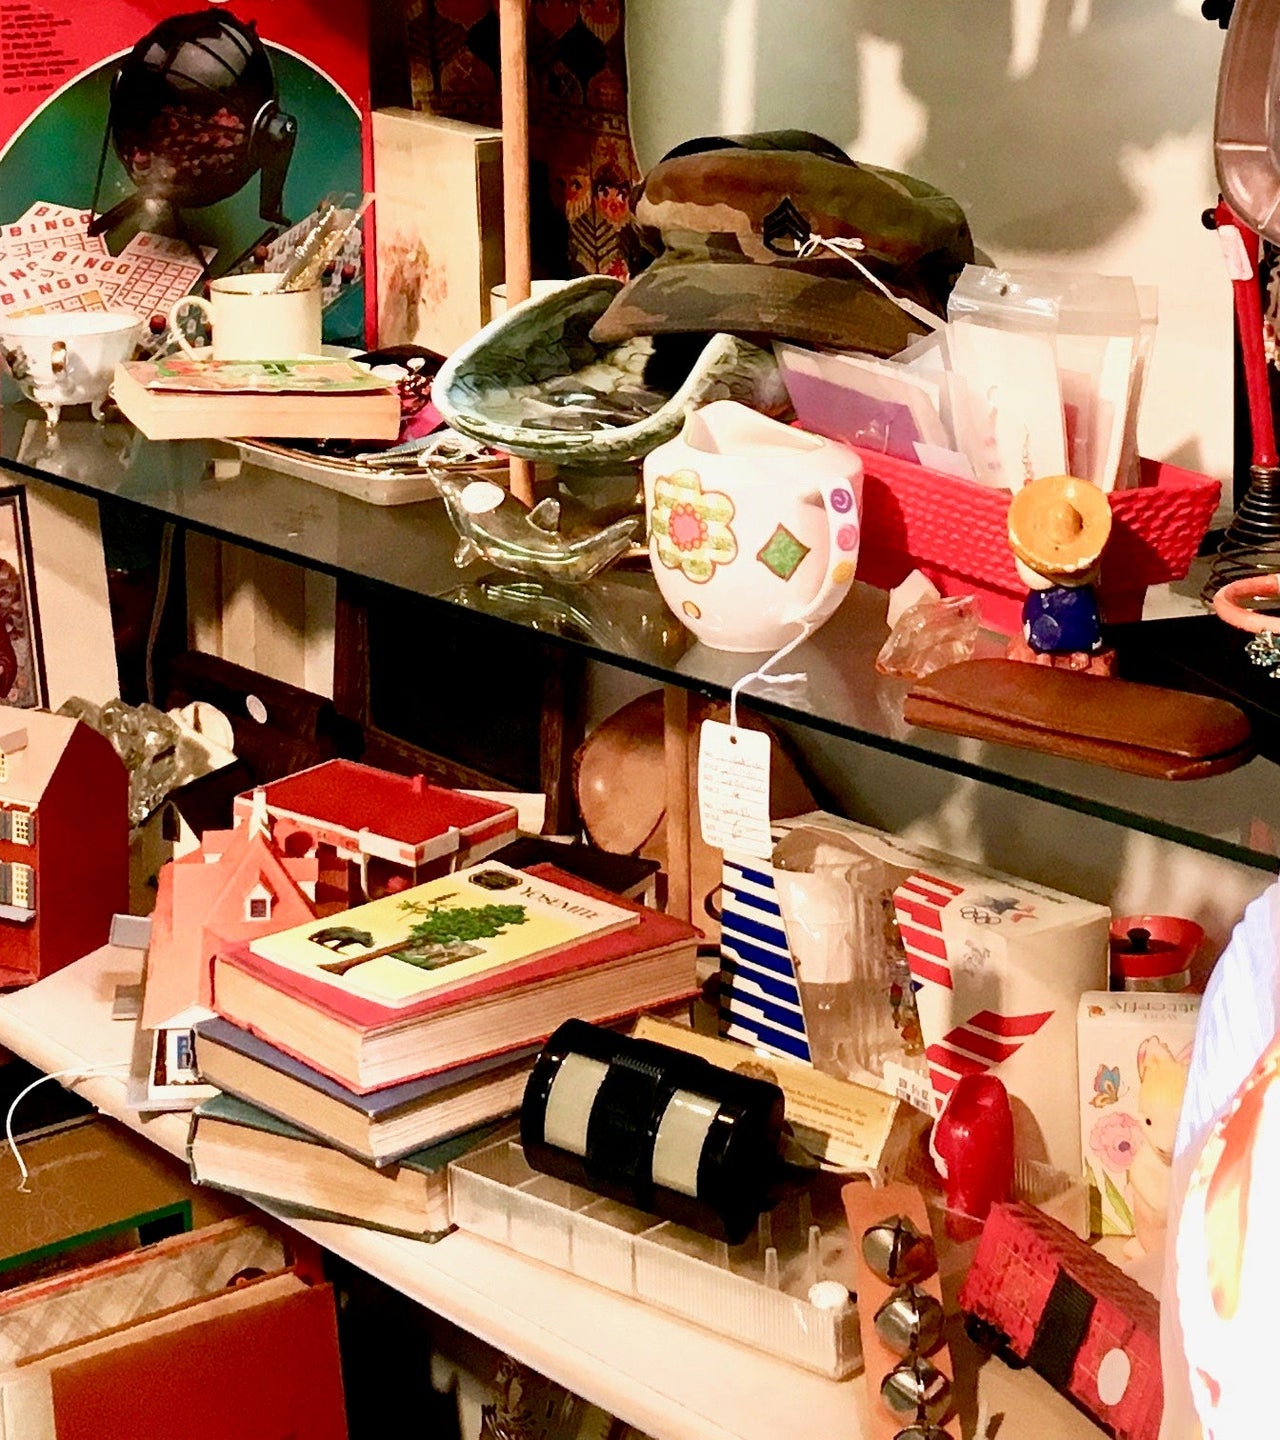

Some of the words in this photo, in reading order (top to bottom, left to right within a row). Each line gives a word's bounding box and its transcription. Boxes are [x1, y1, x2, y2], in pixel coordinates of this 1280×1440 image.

[9, 214, 93, 237] BINGO
[51, 250, 131, 275] BINGO
[0, 273, 89, 306] BINGO
